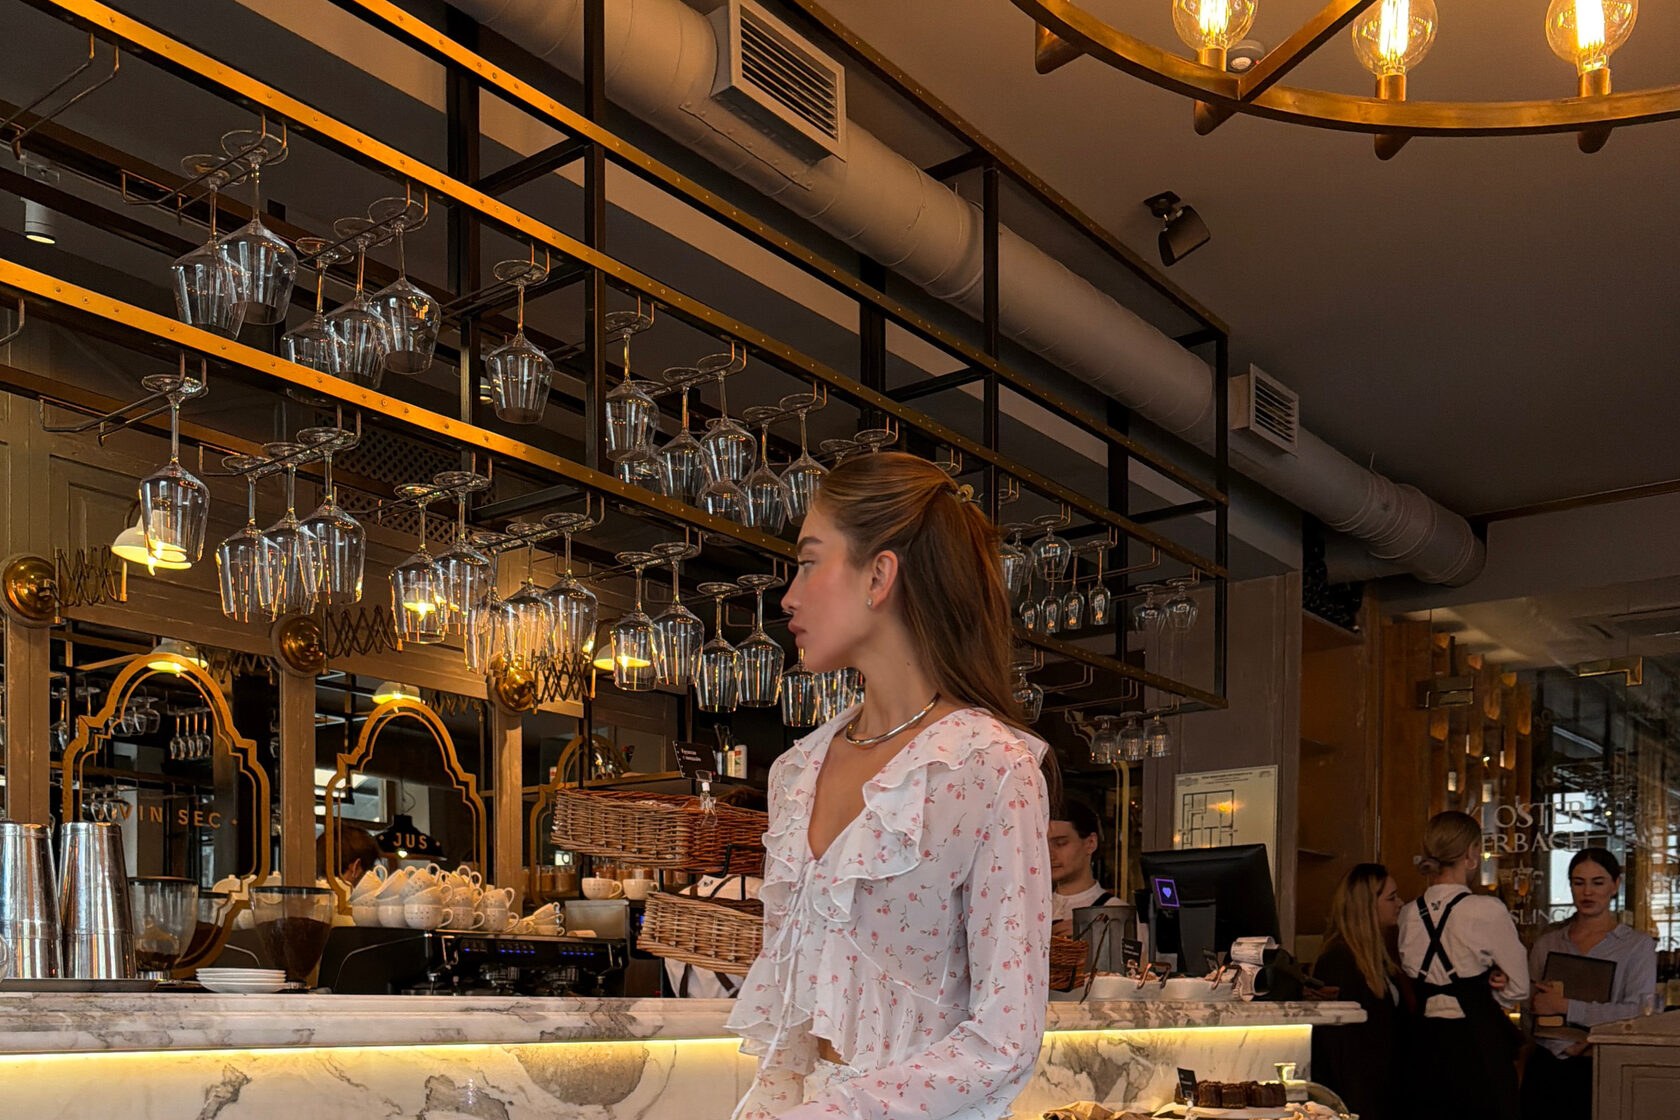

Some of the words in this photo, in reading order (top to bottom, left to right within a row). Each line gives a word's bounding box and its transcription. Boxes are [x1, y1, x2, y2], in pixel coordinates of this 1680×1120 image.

[120, 803, 163, 823] VIN
[178, 809, 221, 829] SEC
[392, 832, 428, 849] JUS
[1481, 830, 1589, 853] ERBACH
